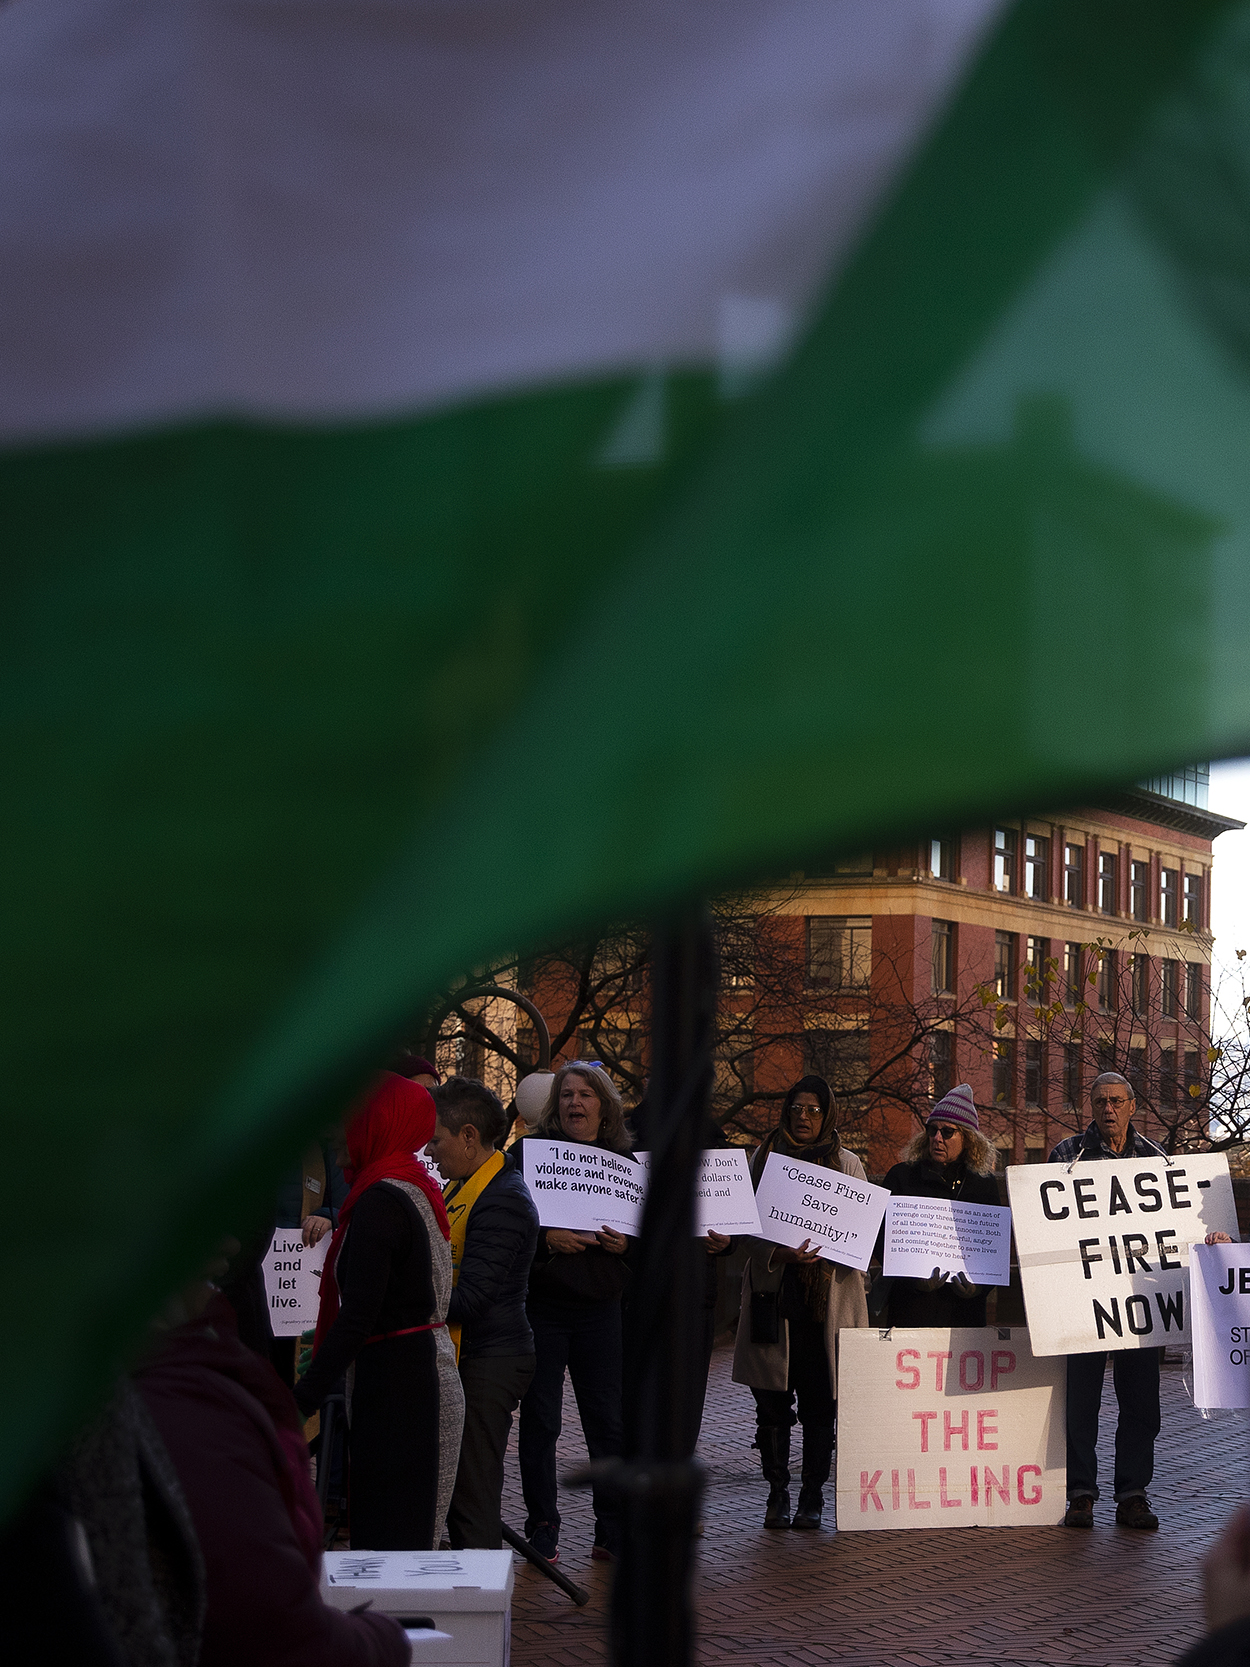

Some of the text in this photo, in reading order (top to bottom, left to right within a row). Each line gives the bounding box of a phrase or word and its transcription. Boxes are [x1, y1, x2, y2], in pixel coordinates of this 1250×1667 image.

[563, 1150, 576, 1161] do
[579, 1153, 598, 1165] not
[601, 1156, 633, 1176] believe
[715, 1158, 739, 1167] Don't
[535, 1162, 581, 1176] violence
[584, 1169, 604, 1180] and
[608, 1174, 644, 1194] revenge
[701, 1173, 743, 1182] dollars to
[535, 1178, 568, 1190] make
[570, 1182, 612, 1196] anyone
[782, 1165, 872, 1205] “Cease Fire!
[696, 1188, 731, 1198] eid and
[1039, 1169, 1211, 1221] CEASE-
[801, 1193, 839, 1216] Save
[919, 1204, 947, 1212] innocent
[948, 1206, 963, 1214] lives
[768, 1205, 858, 1243] humanity!”
[935, 1214, 966, 1224] threatens
[955, 1226, 984, 1235] innocent.
[985, 1229, 1001, 1237] Both
[273, 1240, 303, 1252] Live
[930, 1240, 959, 1249] together
[973, 1237, 993, 1246] angry
[930, 1250, 944, 1258] way
[1078, 1229, 1182, 1280] FIRE
[274, 1259, 301, 1271] and
[278, 1277, 297, 1289] let
[271, 1295, 301, 1308] live.
[1092, 1290, 1184, 1340] NOW
[895, 1348, 1017, 1392] STOP
[912, 1409, 998, 1453] THE
[860, 1464, 1043, 1512] KILLING
